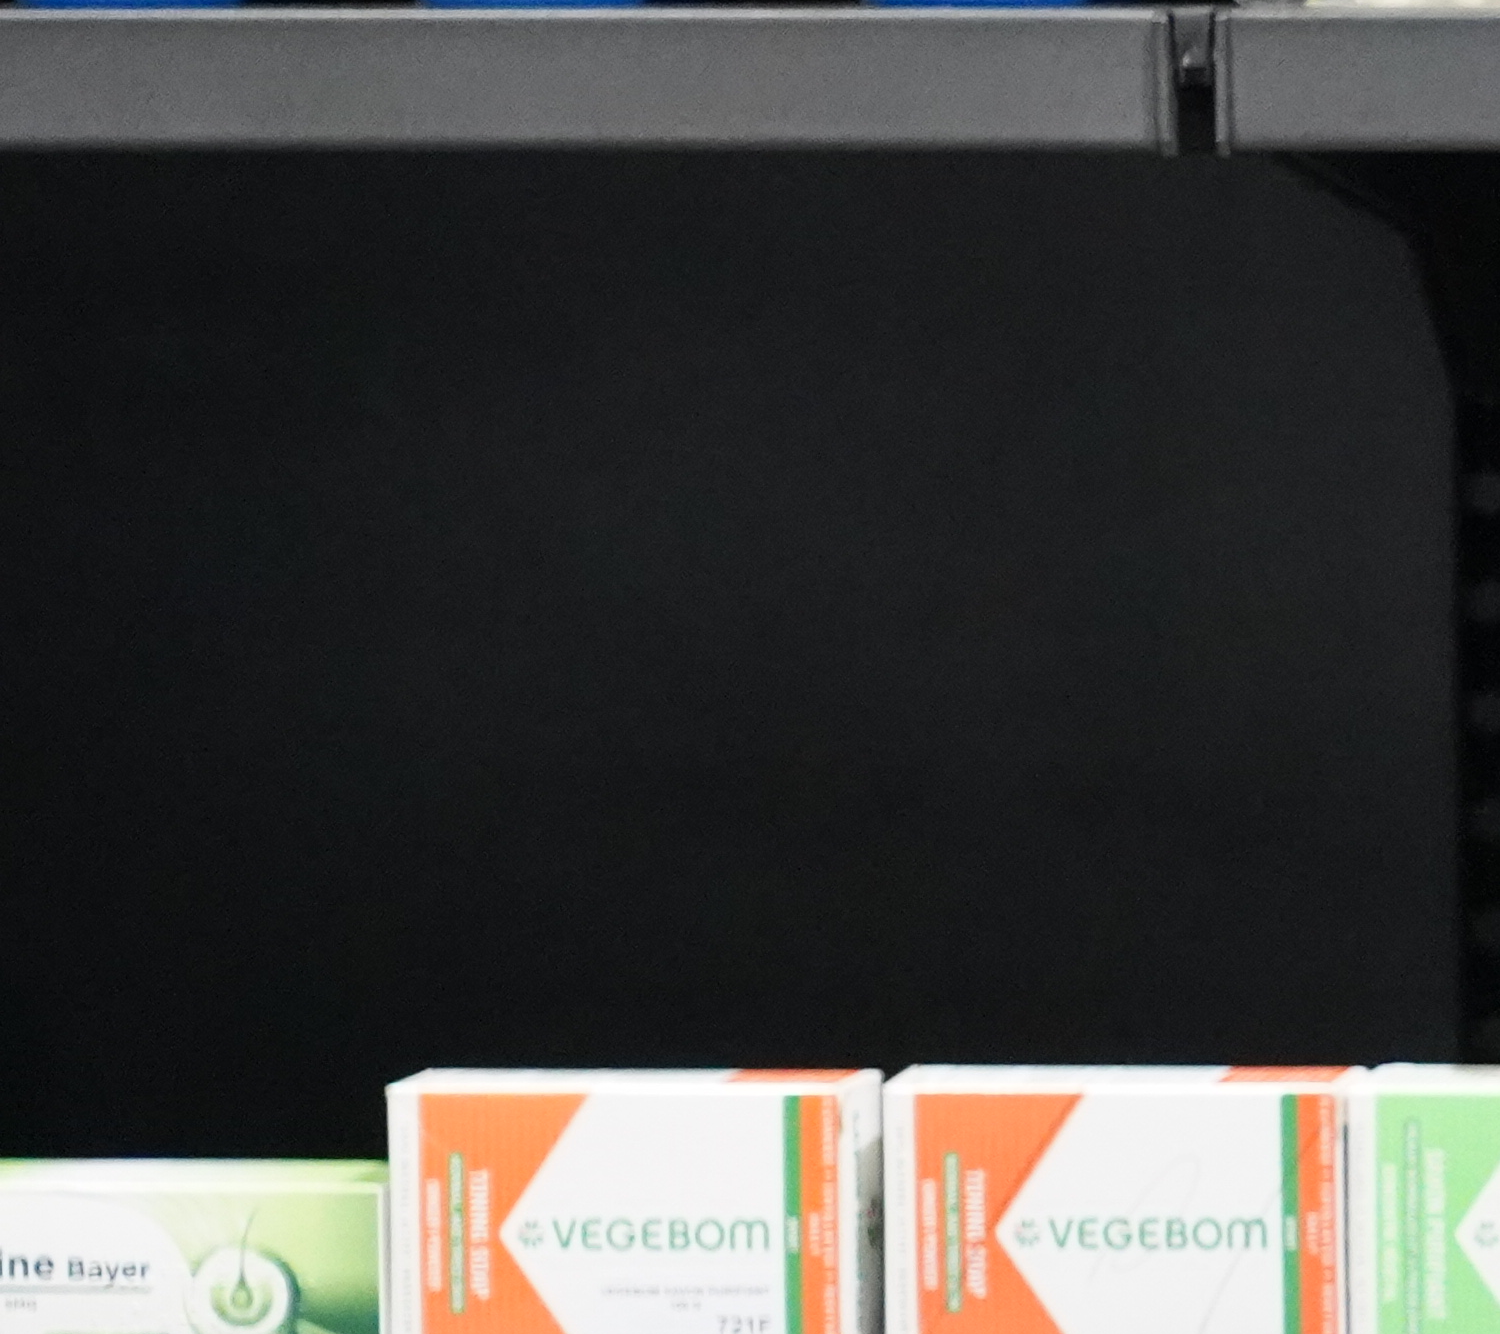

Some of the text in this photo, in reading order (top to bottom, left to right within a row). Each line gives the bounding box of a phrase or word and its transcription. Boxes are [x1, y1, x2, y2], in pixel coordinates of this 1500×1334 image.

[552, 1217, 771, 1252] VEGEBOM
[1049, 1217, 1268, 1250] VEGEBOM
[67, 1254, 152, 1289] Bayer
